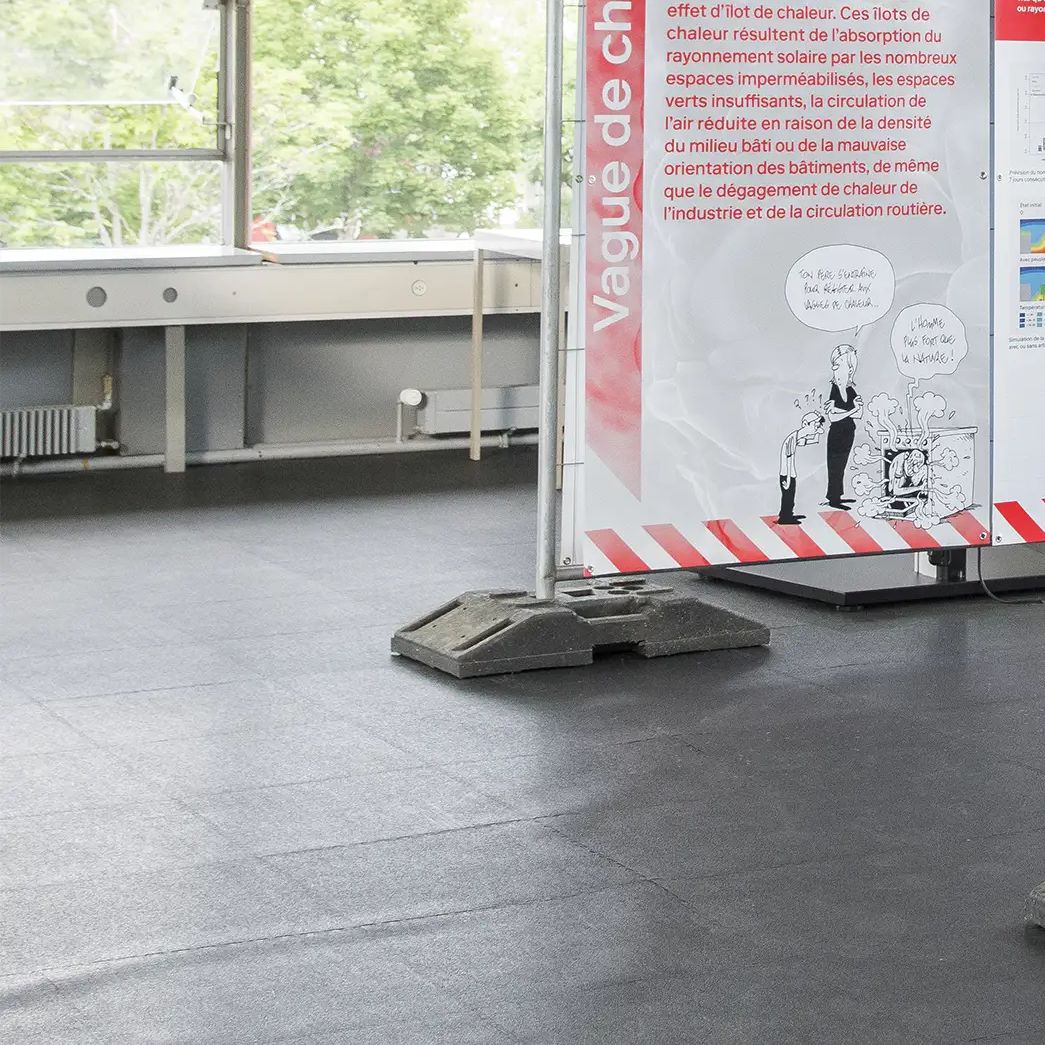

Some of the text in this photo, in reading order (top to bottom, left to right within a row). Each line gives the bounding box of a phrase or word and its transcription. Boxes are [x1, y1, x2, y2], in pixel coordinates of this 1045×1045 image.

[595, 78, 631, 147] de
[665, 93, 926, 110] verts insuffisants, la circulation de
[664, 158, 939, 175] orientation des bâtiments, de même
[592, 160, 639, 331] Vague
